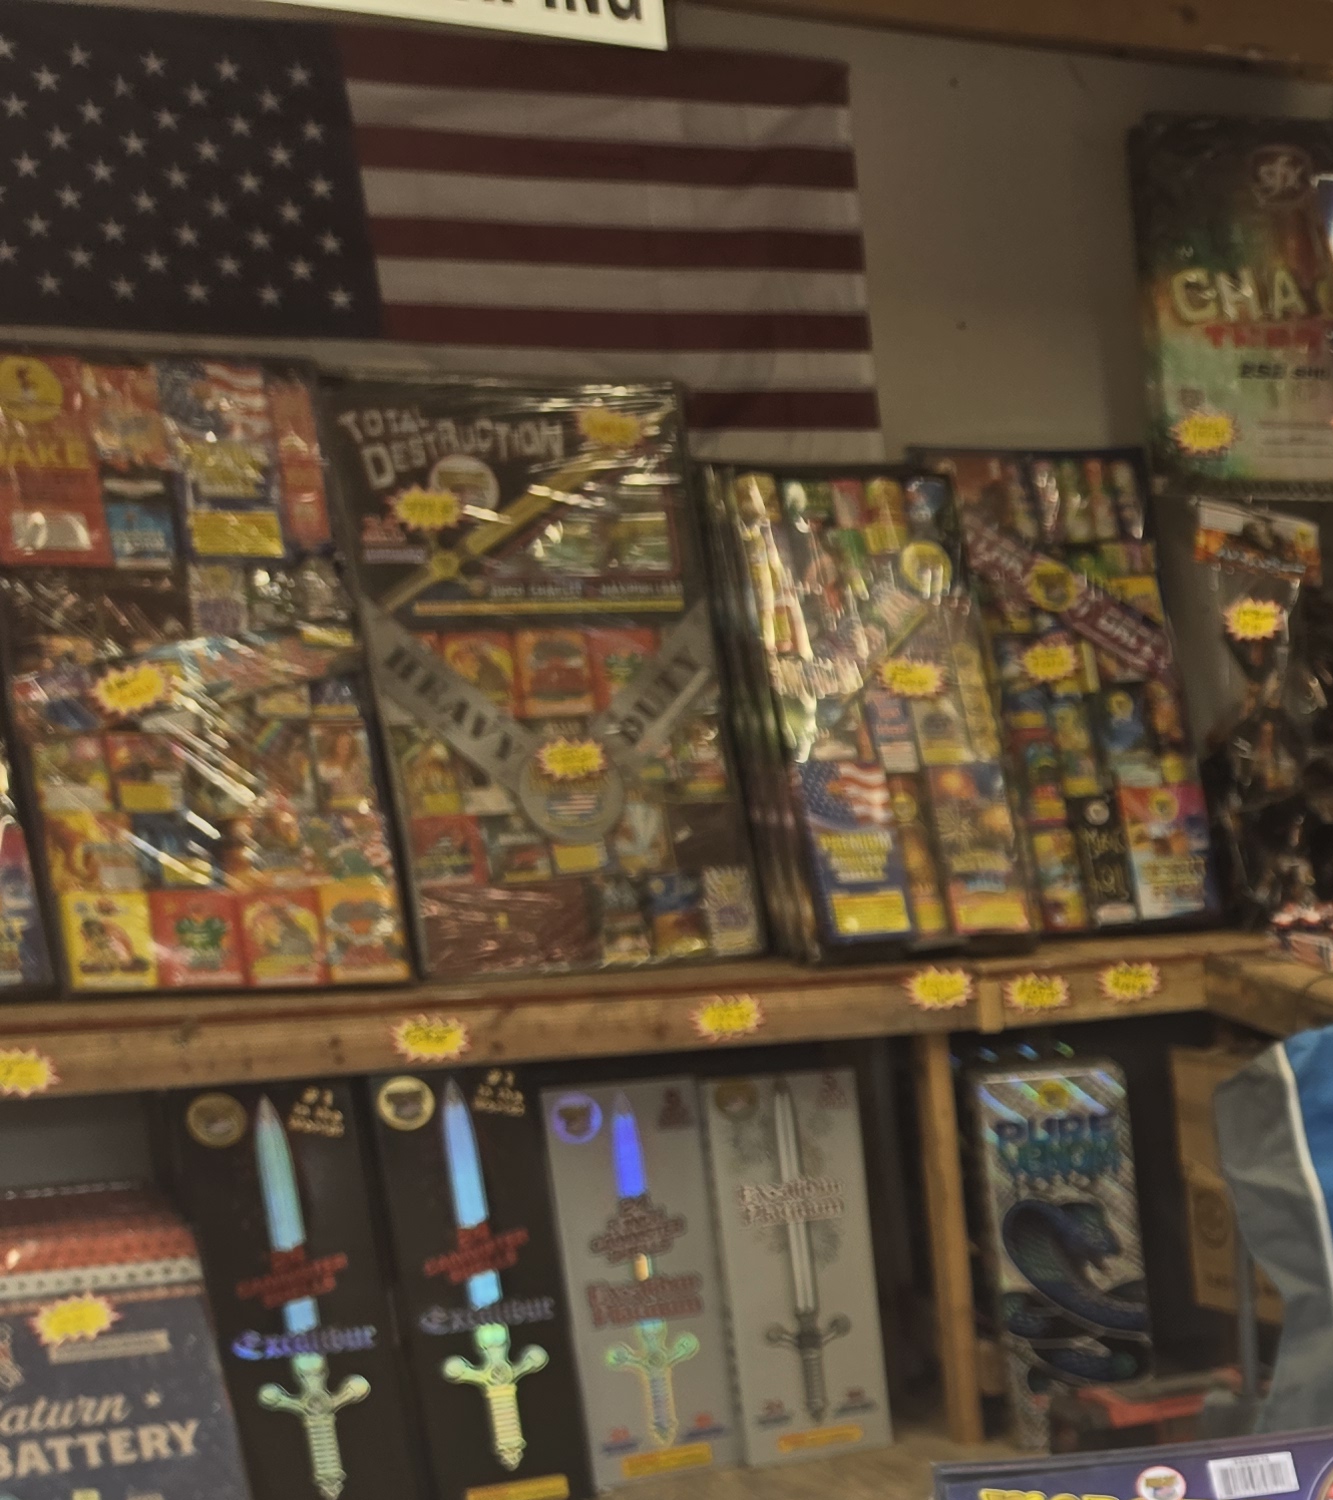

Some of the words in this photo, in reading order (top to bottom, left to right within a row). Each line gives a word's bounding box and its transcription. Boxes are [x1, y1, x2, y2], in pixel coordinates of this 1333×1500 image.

[339, 404, 429, 443] TOTAL
[361, 418, 565, 489] DESTRUCTION
[233, 1324, 376, 1361] Excalibur
[0, 1393, 133, 1437] aturn
